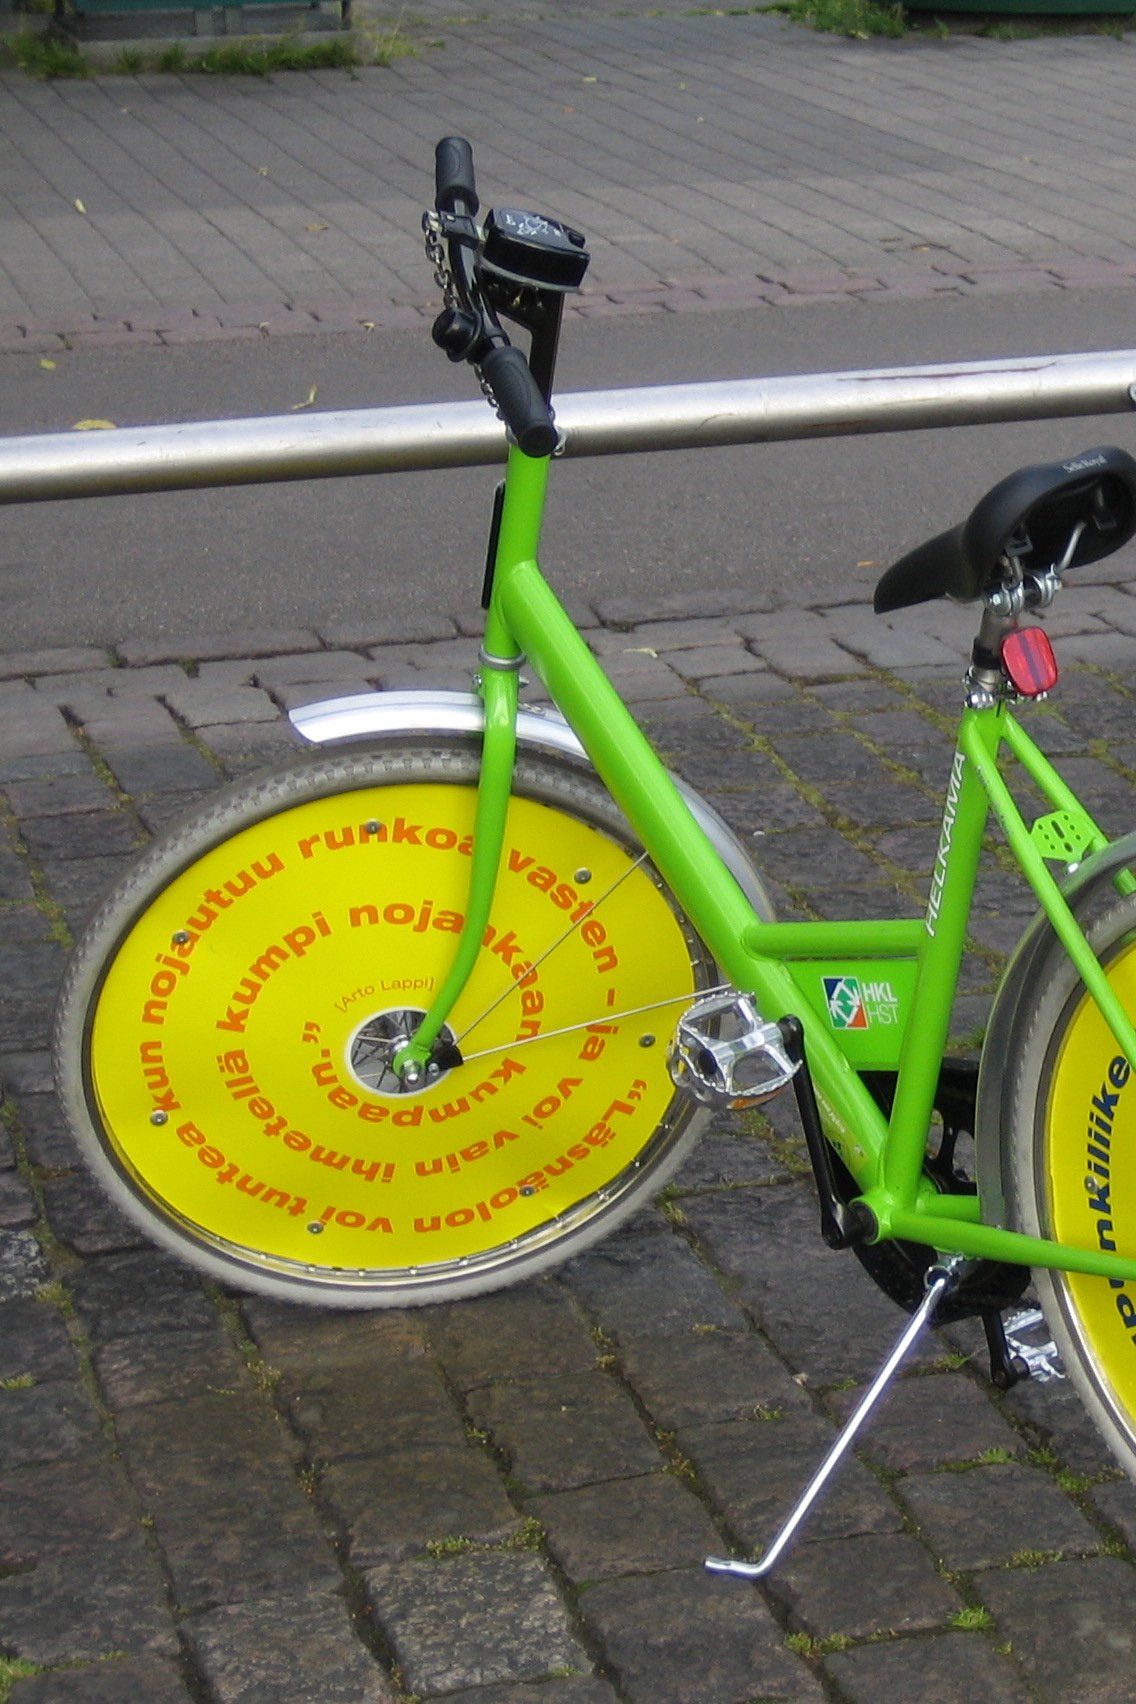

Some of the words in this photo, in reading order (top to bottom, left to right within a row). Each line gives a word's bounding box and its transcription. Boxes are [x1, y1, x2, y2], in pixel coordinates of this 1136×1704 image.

[924, 751, 967, 938] HELKAMA
[141, 852, 285, 1026] nojautuu
[508, 848, 619, 974] vasten
[216, 911, 332, 1033] kumpi
[860, 981, 898, 1003] HKL
[578, 1023, 620, 1061] ja
[867, 1003, 899, 1025] HST
[139, 1040, 182, 1113] kun
[521, 1077, 584, 1130] voi
[216, 1049, 396, 1183] ihmetellä
[176, 1122, 308, 1217] tuntea
[415, 1129, 520, 1177] vain
[320, 1205, 394, 1234] voi
